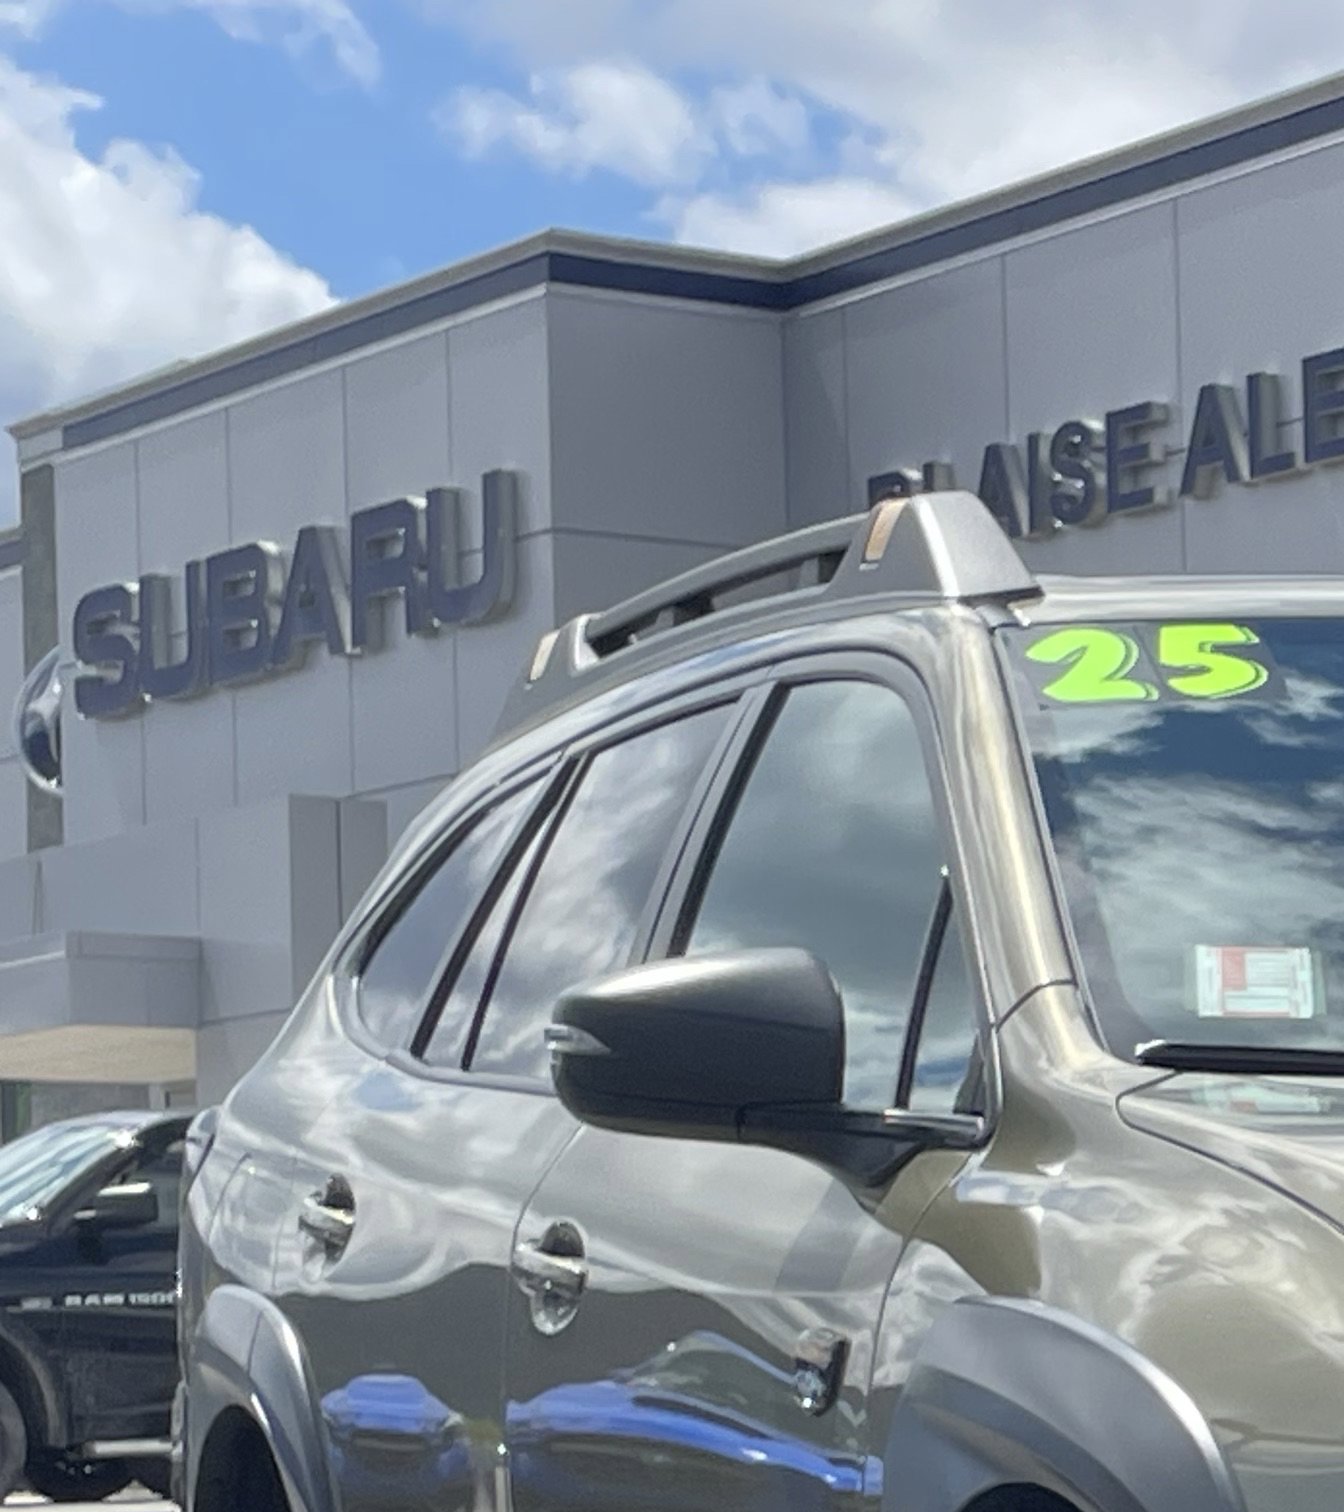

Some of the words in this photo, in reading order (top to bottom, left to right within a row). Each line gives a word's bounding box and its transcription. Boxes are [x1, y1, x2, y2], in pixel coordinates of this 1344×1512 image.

[73, 469, 518, 720] SUBARU
[1025, 623, 1269, 703] 25
[64, 1293, 125, 1307] RAM
